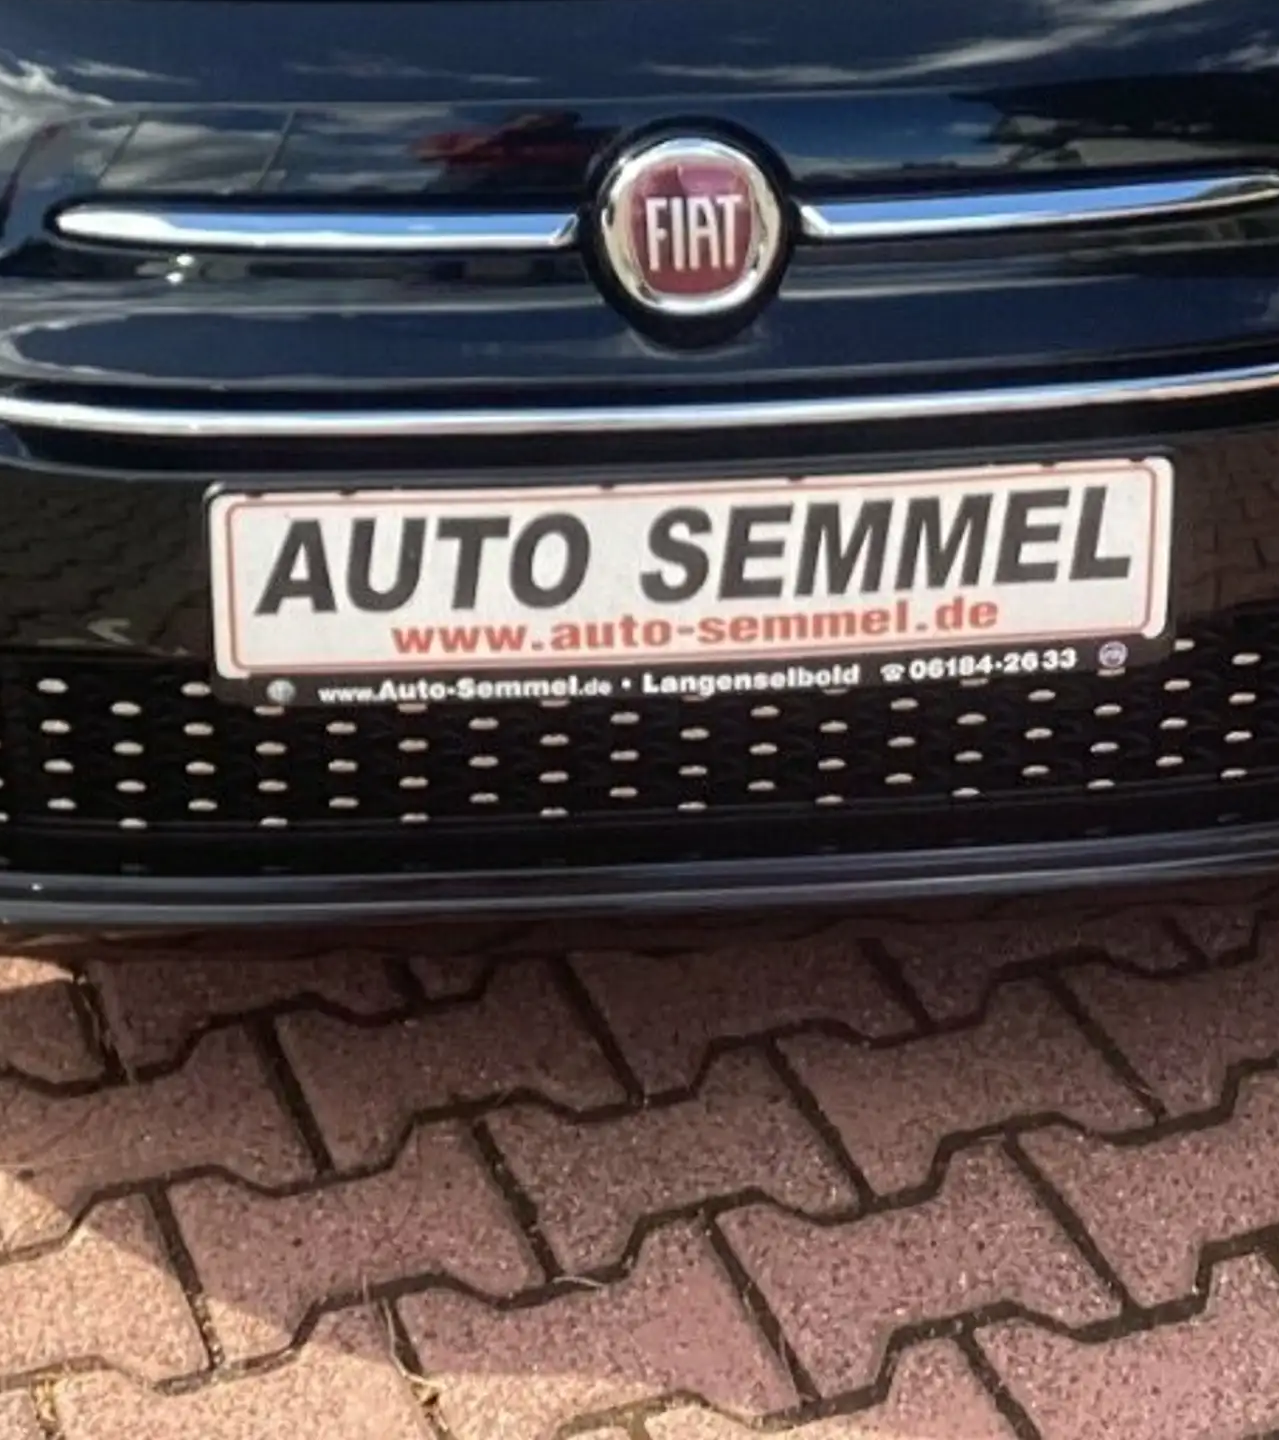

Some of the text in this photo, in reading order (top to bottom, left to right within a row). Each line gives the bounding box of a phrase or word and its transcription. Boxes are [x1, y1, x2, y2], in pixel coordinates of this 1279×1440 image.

[646, 195, 742, 271] FIAT
[254, 486, 1131, 616] AUTO SEMMEL
[392, 596, 998, 655] www.auto-semmel.de
[318, 674, 613, 703] www.Auto-Semmel.de
[642, 664, 861, 697] Langenselbold
